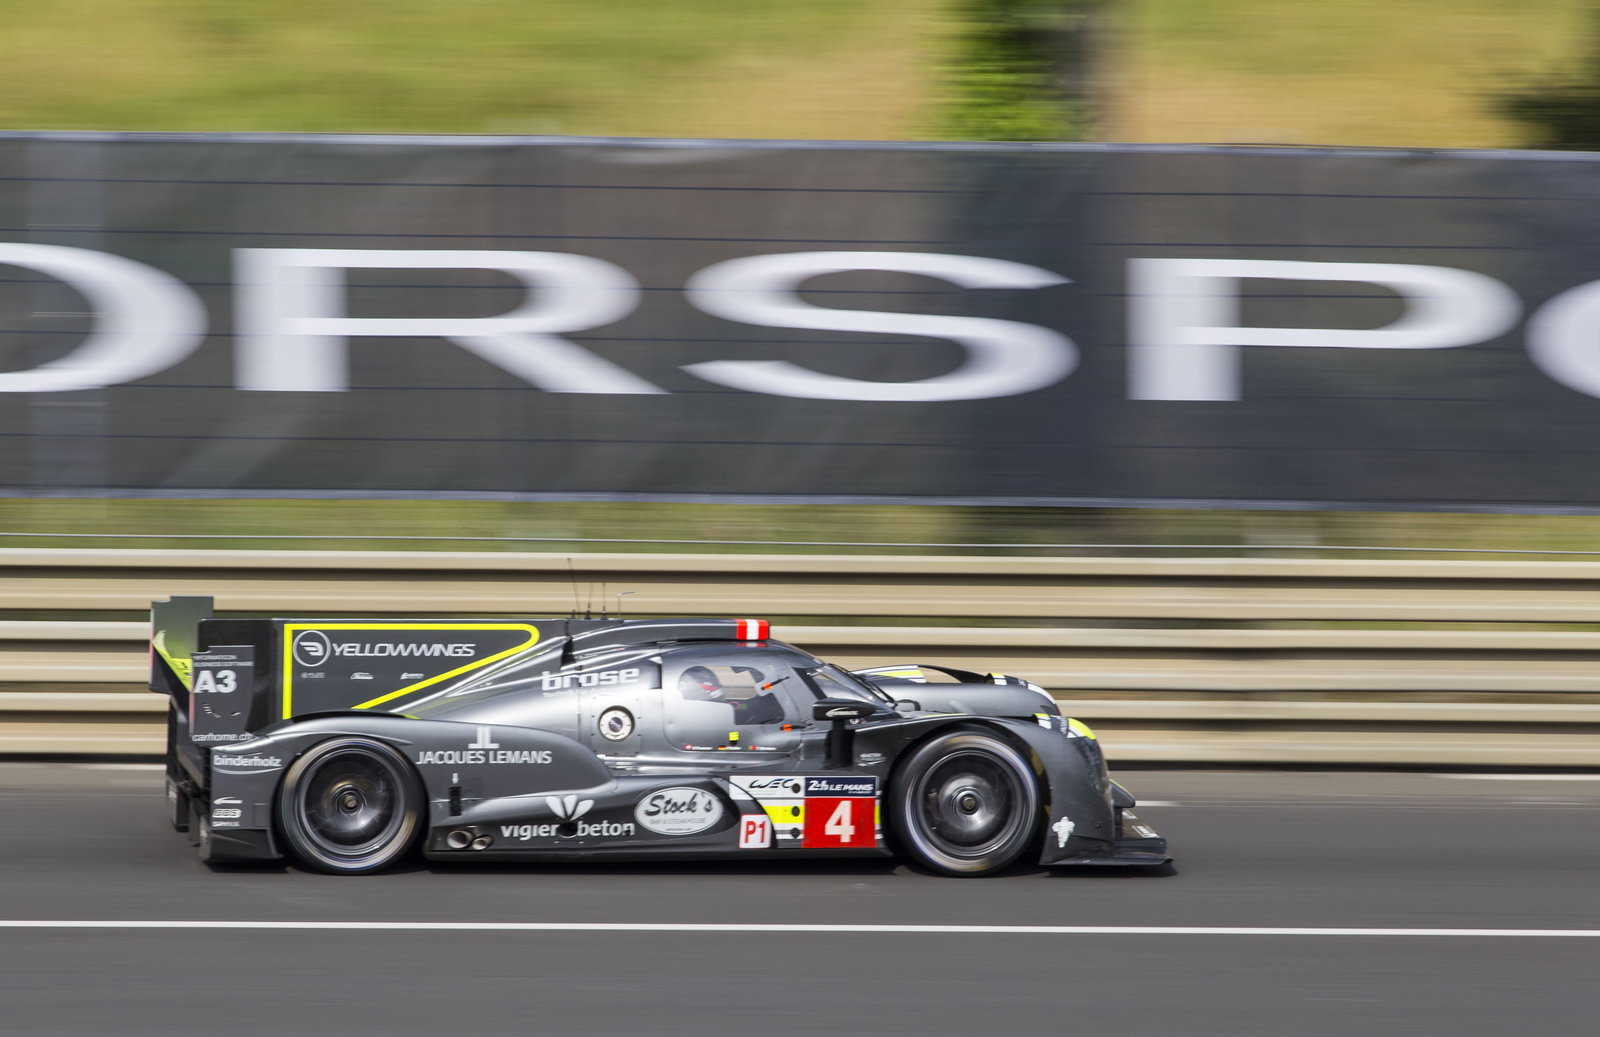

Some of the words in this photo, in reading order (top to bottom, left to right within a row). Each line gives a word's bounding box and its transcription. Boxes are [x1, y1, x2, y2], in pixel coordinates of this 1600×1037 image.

[332, 643, 476, 657] YELLOWWINGS
[193, 670, 237, 693] A3
[542, 667, 639, 690] brose
[213, 755, 282, 767] binderholz
[416, 750, 486, 764] JACQUES
[489, 750, 553, 764] LEMANS
[501, 823, 560, 840] vigier
[577, 820, 635, 836] beton
[744, 820, 766, 843] P1
[824, 800, 855, 843] 4
